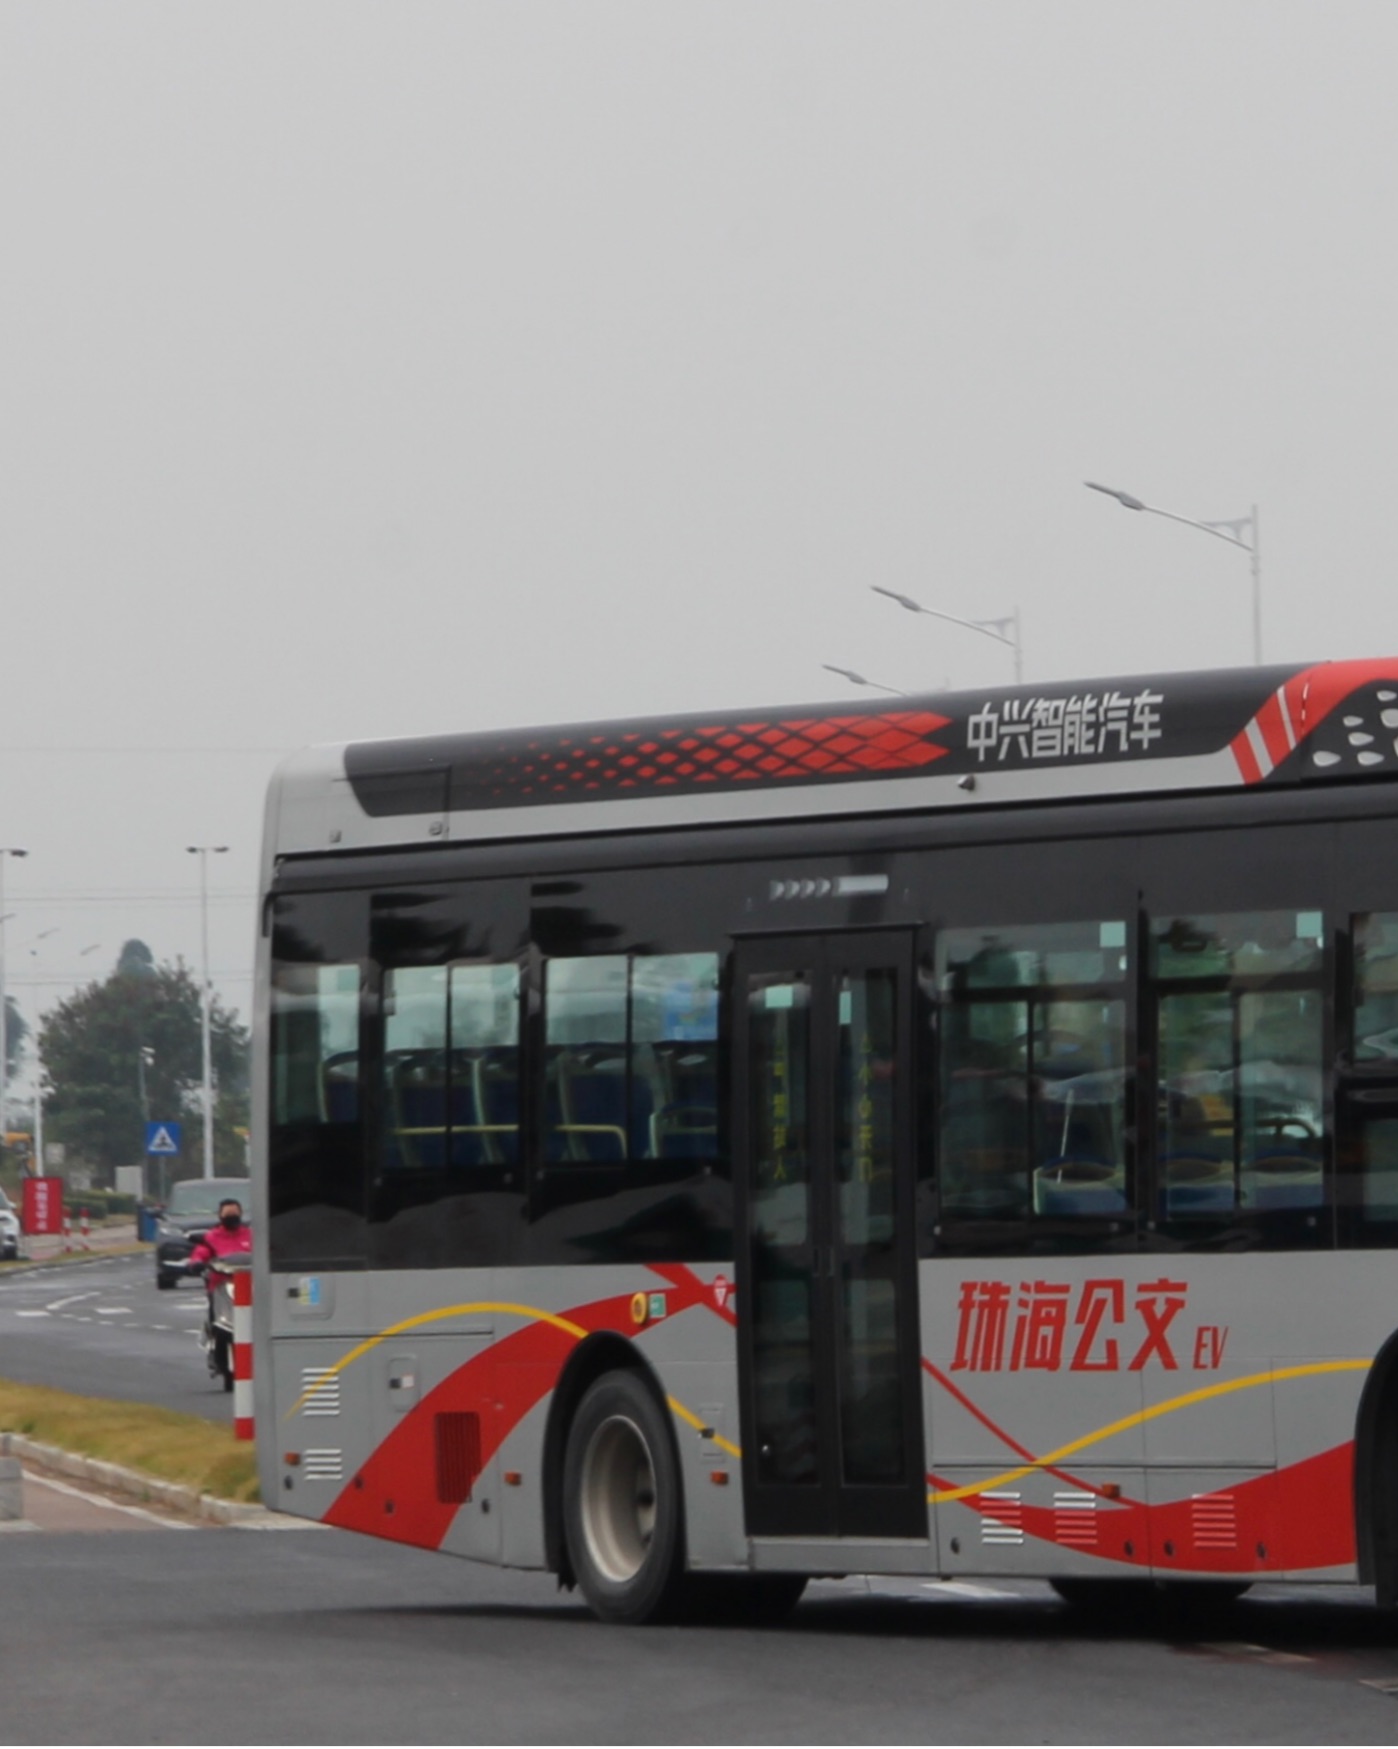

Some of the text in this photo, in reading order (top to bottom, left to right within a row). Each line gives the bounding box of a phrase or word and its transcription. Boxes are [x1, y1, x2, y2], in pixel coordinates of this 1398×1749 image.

[967, 689, 1164, 762] 中兴智能汽车
[950, 1278, 1229, 1372] 珠海公交 EV
